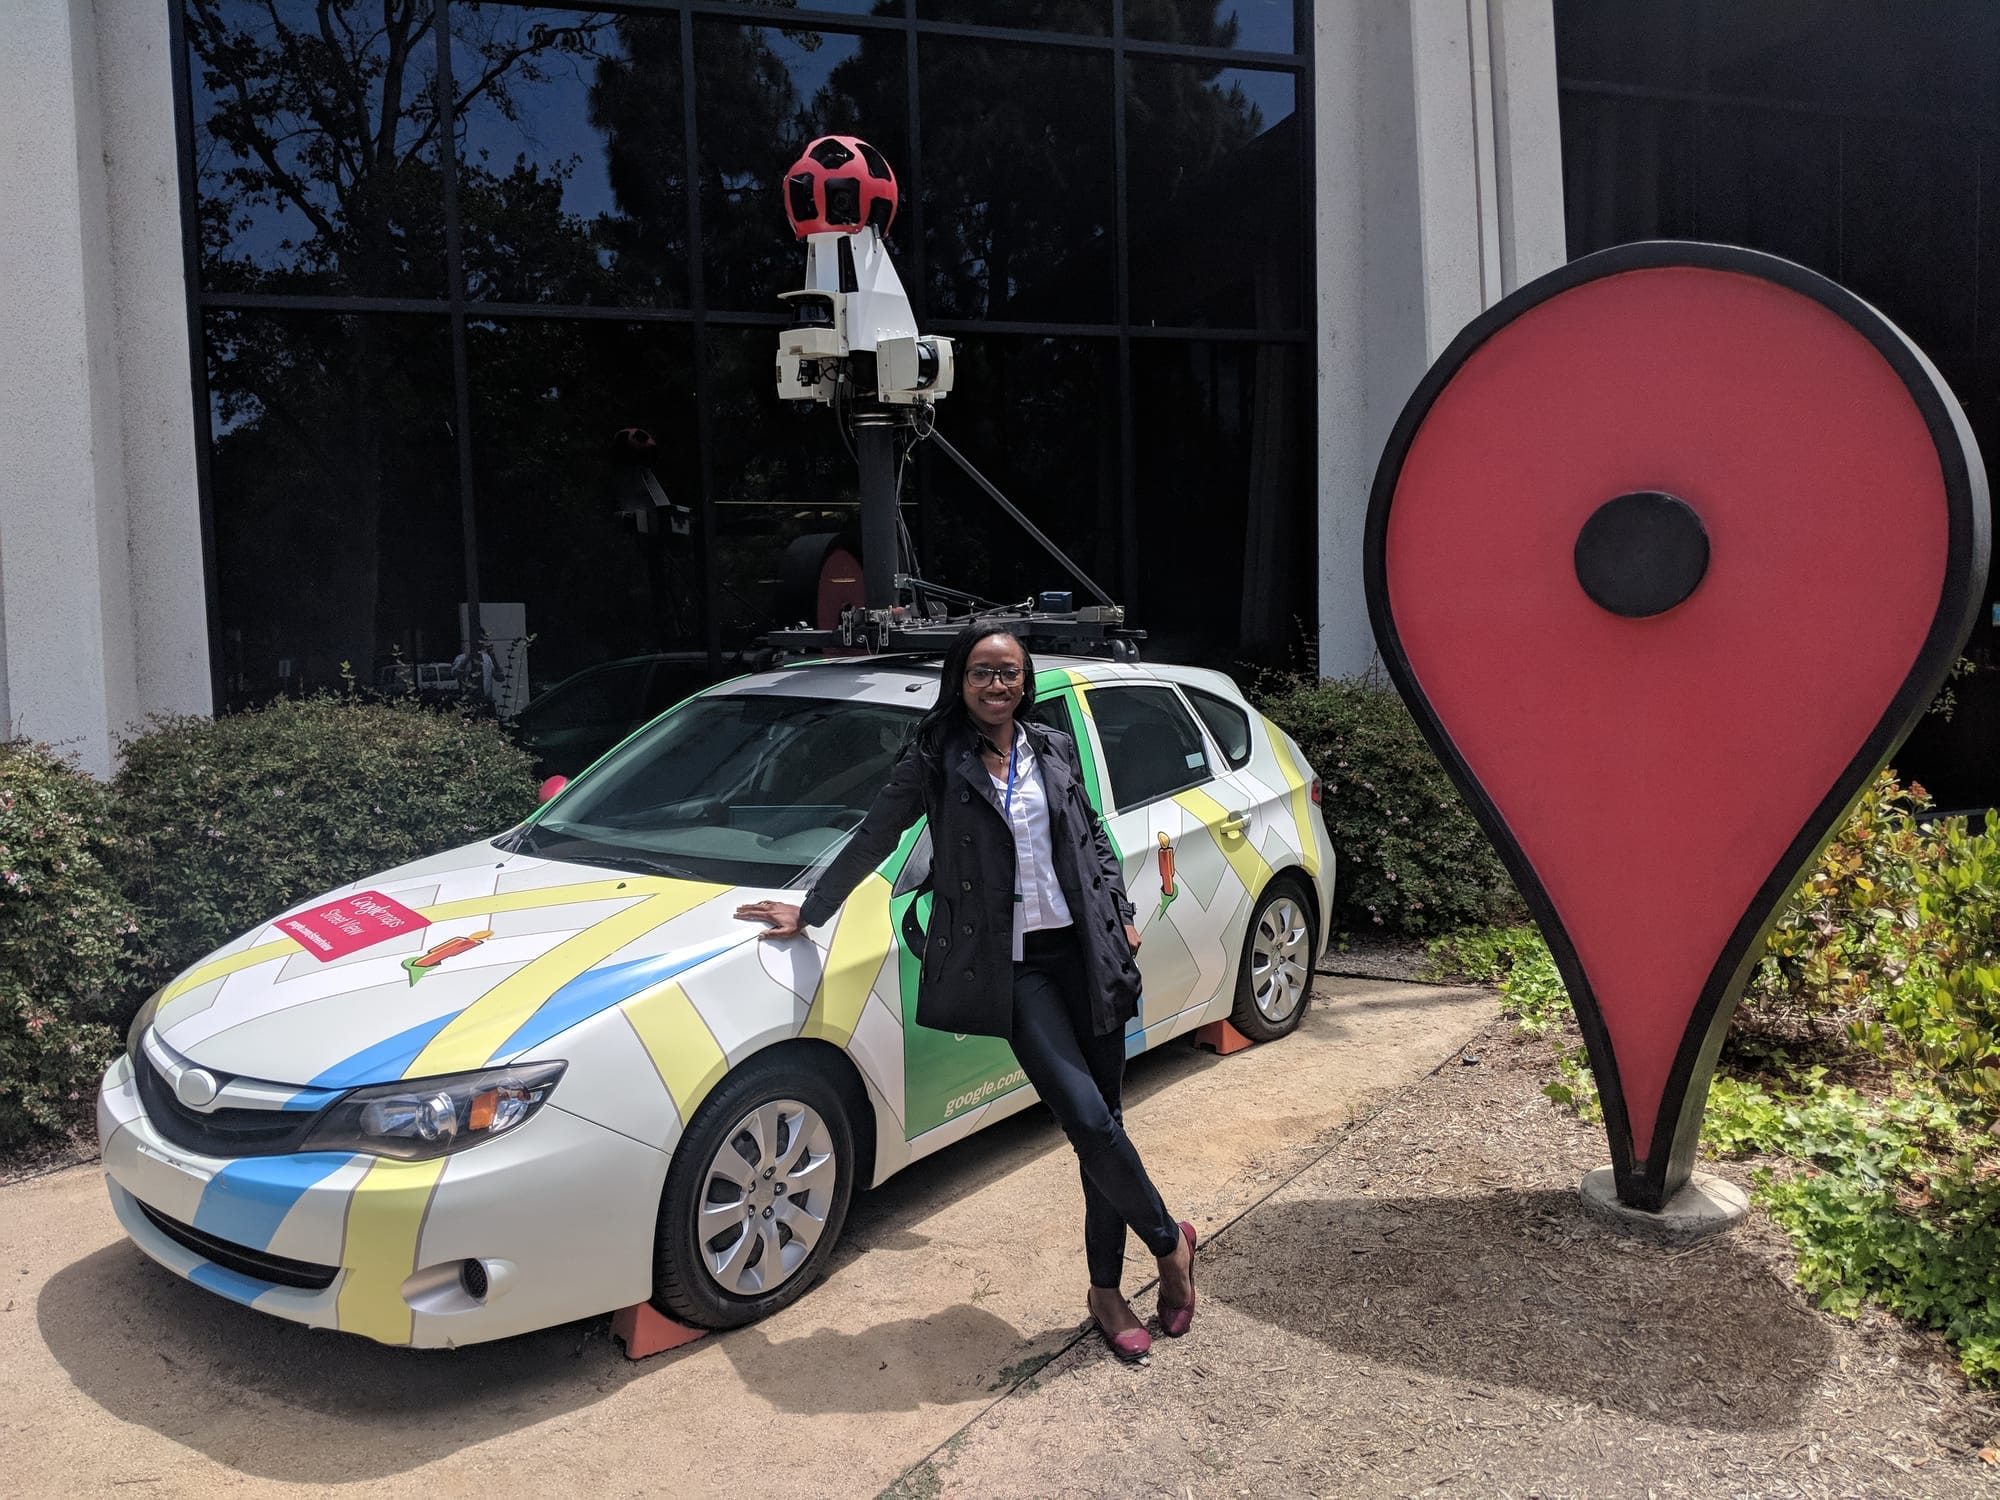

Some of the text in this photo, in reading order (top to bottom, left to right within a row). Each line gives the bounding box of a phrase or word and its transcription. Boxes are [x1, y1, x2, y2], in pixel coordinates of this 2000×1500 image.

[320, 908, 366, 936] Street View
[350, 896, 405, 928] Google maps
